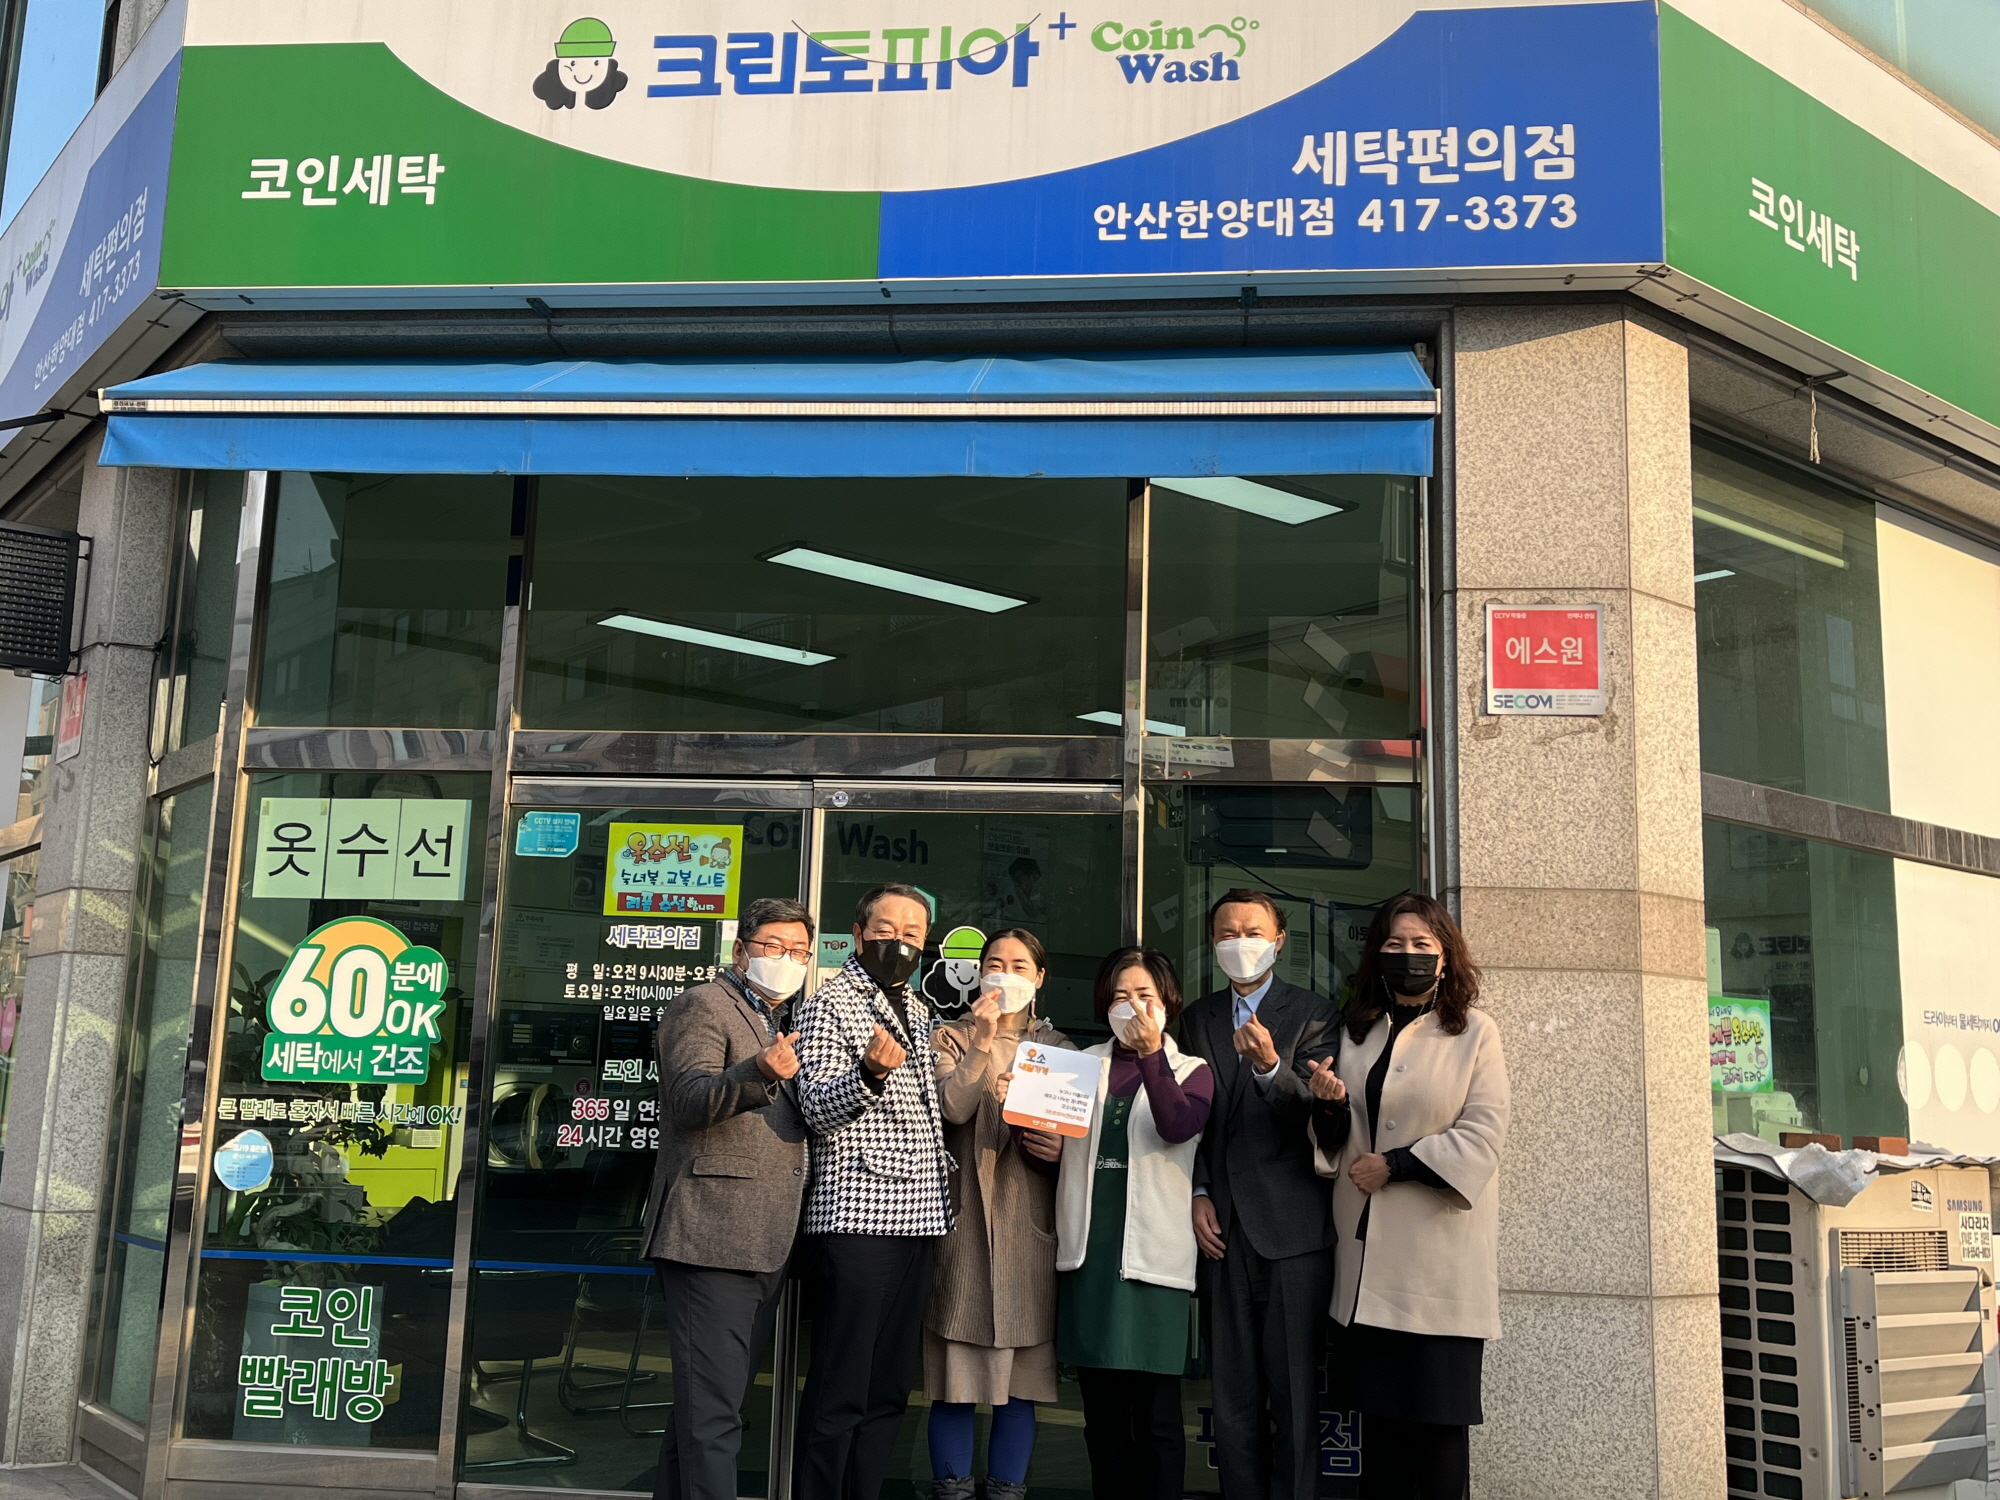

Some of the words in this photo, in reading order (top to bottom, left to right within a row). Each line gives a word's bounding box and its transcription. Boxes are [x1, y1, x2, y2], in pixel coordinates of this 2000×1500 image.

[1090, 18, 1195, 54] Coin
[1116, 51, 1242, 84] Wash
[1291, 123, 1578, 187] 세탁편의점
[241, 153, 445, 206] 코인세탁
[1093, 196, 1335, 241] 안산한양대점
[1357, 193, 1578, 233] 417-3373
[1748, 175, 1862, 282] 코인세탁
[79, 186, 149, 298] 세탁편의점
[34, 309, 86, 391] 안산한양대점
[88, 249, 142, 328] 417-3373
[1505, 636, 1584, 666] 에스원
[1493, 694, 1553, 710] SECOM
[266, 822, 455, 878] 옷수선
[627, 831, 693, 864] 옷수선
[836, 818, 929, 866] Wash
[625, 891, 654, 912] 리폼
[606, 924, 702, 949] 세탁편의점
[822, 940, 849, 951] TOP
[270, 946, 388, 1038] 60
[390, 961, 443, 993] 분에
[386, 999, 441, 1039] OK
[603, 1005, 652, 1021] 일요일은
[266, 1041, 363, 1075] 세탁에서
[369, 1043, 424, 1077] 건조
[602, 1059, 643, 1083] 코인
[218, 1098, 237, 1119] 큰
[239, 1099, 287, 1121] 빨래도
[289, 1099, 339, 1123] 혼자서
[341, 1101, 376, 1123] 빠른
[377, 1103, 425, 1124] 시간에
[427, 1105, 462, 1126] OK!
[571, 1098, 610, 1120] 365
[557, 1125, 584, 1147] 24
[585, 1126, 623, 1148] 시간
[1946, 1199, 1983, 1212] SAMSUNG
[1961, 1216, 1989, 1231] 사다리차
[271, 1286, 373, 1348] 코인
[238, 1355, 394, 1422] 빨래방
